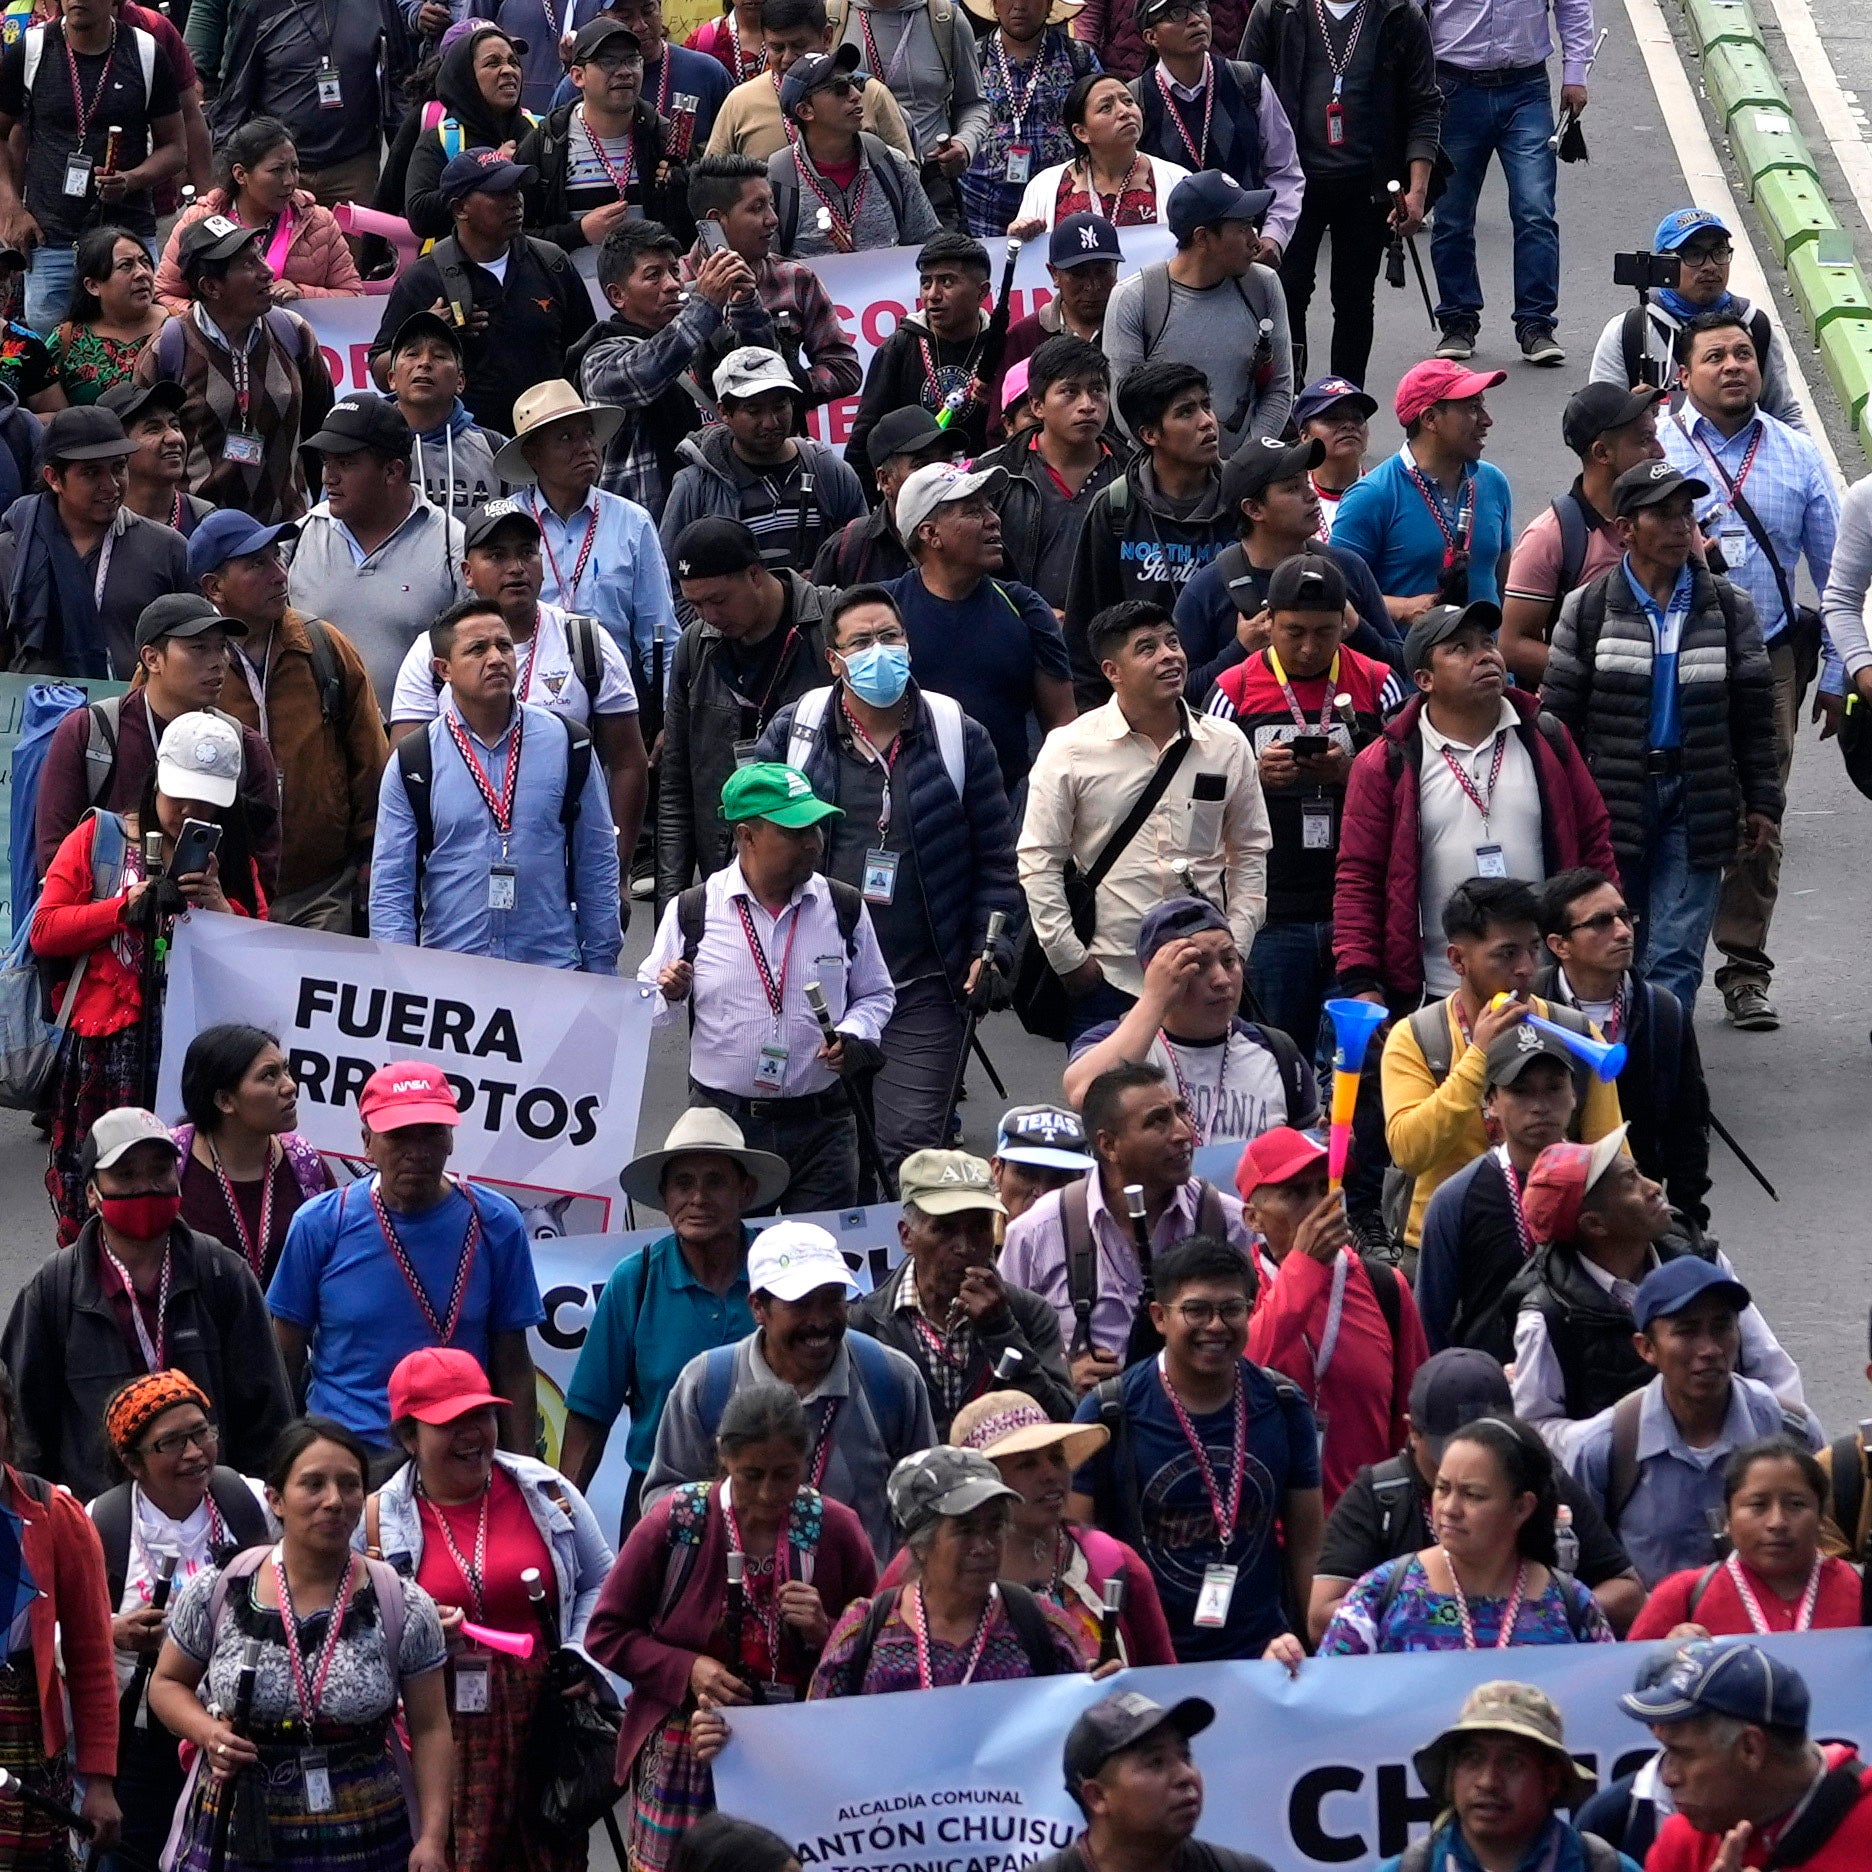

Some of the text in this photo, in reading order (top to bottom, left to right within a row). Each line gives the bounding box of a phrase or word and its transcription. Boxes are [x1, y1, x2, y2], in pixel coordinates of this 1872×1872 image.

[1078, 225, 1099, 248] NY
[679, 560, 690, 575] NY
[296, 977, 523, 1063] FUERA
[392, 1080, 432, 1094] NASA
[1017, 1113, 1079, 1137] TEXAS
[1041, 1128, 1057, 1142] T
[837, 1788, 1023, 1822] ALCALDÍA COMUNAL
